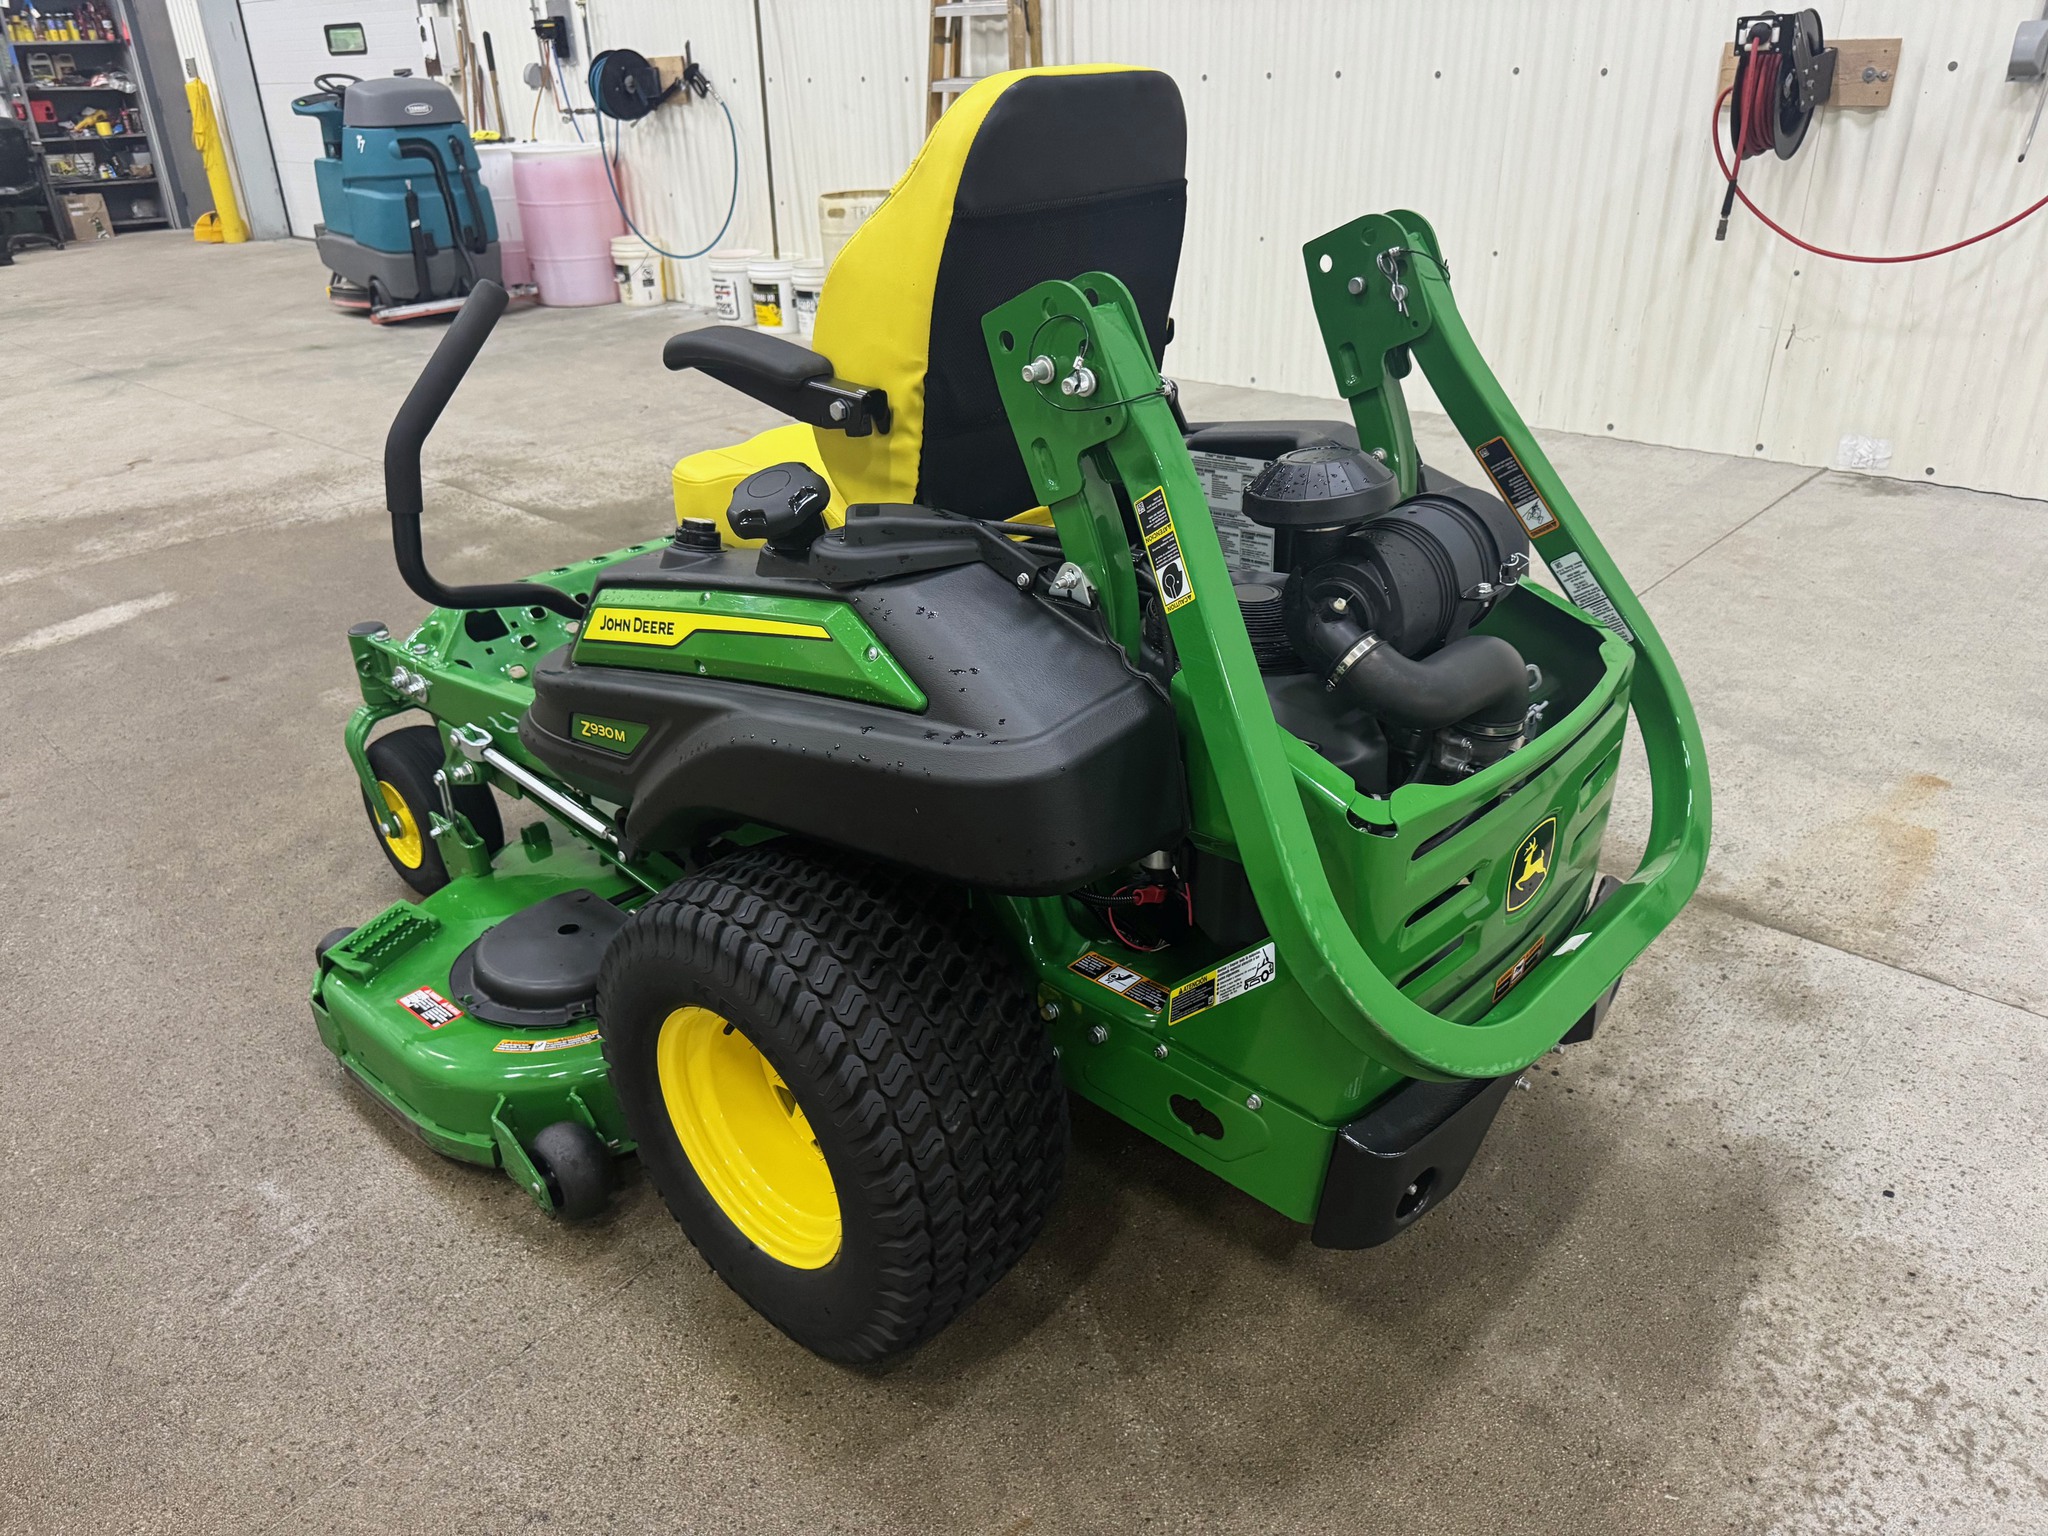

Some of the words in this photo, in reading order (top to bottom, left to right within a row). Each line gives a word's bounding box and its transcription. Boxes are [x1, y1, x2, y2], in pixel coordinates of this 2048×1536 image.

[1167, 596, 1189, 612] CAUTION
[600, 615, 631, 632] JOHN
[633, 617, 675, 635] DEERE
